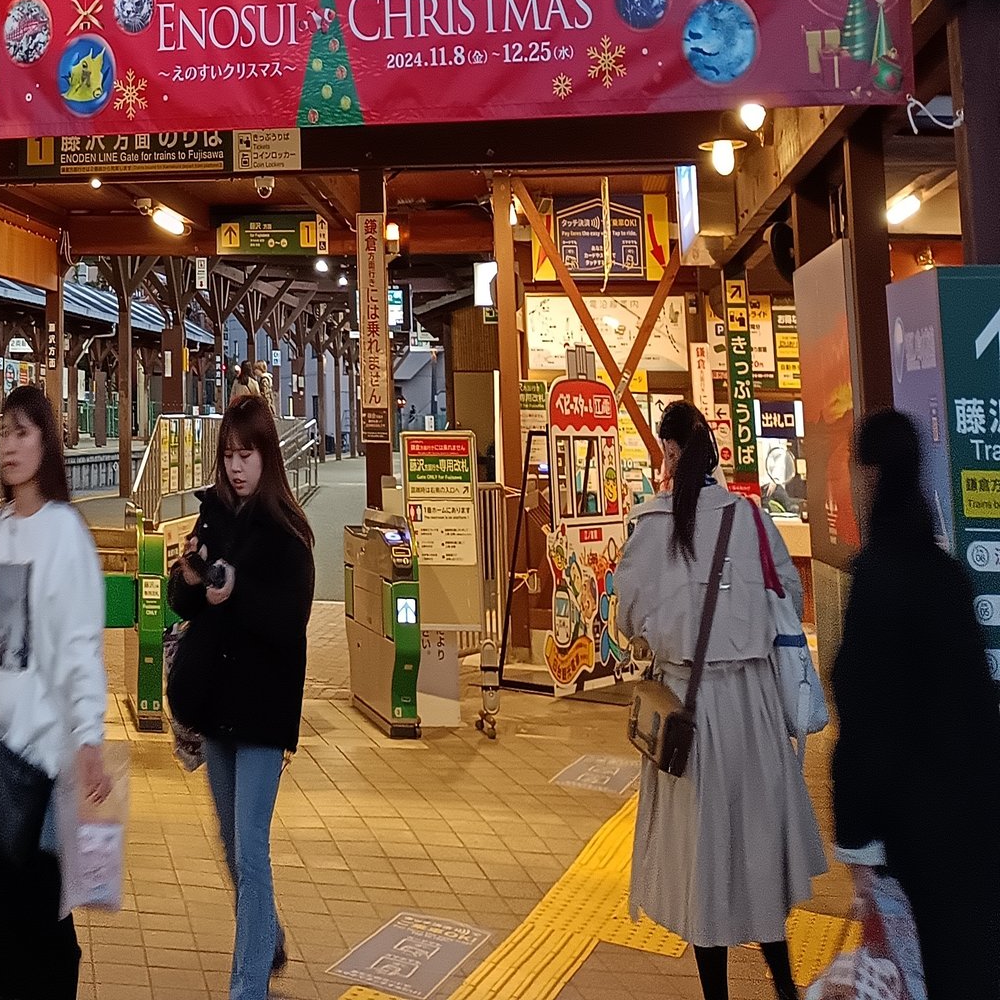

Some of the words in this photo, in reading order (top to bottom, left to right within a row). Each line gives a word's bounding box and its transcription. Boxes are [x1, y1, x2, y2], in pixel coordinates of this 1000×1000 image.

[156, 1, 299, 53] ENOSUI
[252, 132, 290, 143] きっぷうりば
[60, 152, 97, 164] ENODEN
[98, 151, 117, 162] LINE
[119, 151, 139, 162] Gate
[140, 150, 152, 161] for
[153, 150, 177, 161] trains
[178, 150, 187, 160] to
[188, 148, 224, 162] Fujisawa
[252, 151, 296, 160] コインロッカー
[305, 225, 310, 243] 1
[363, 218, 381, 405] 鎌倉方面行きには乗れません
[730, 335, 756, 465] きっぷうりば
[761, 412, 795, 428] 出札口
